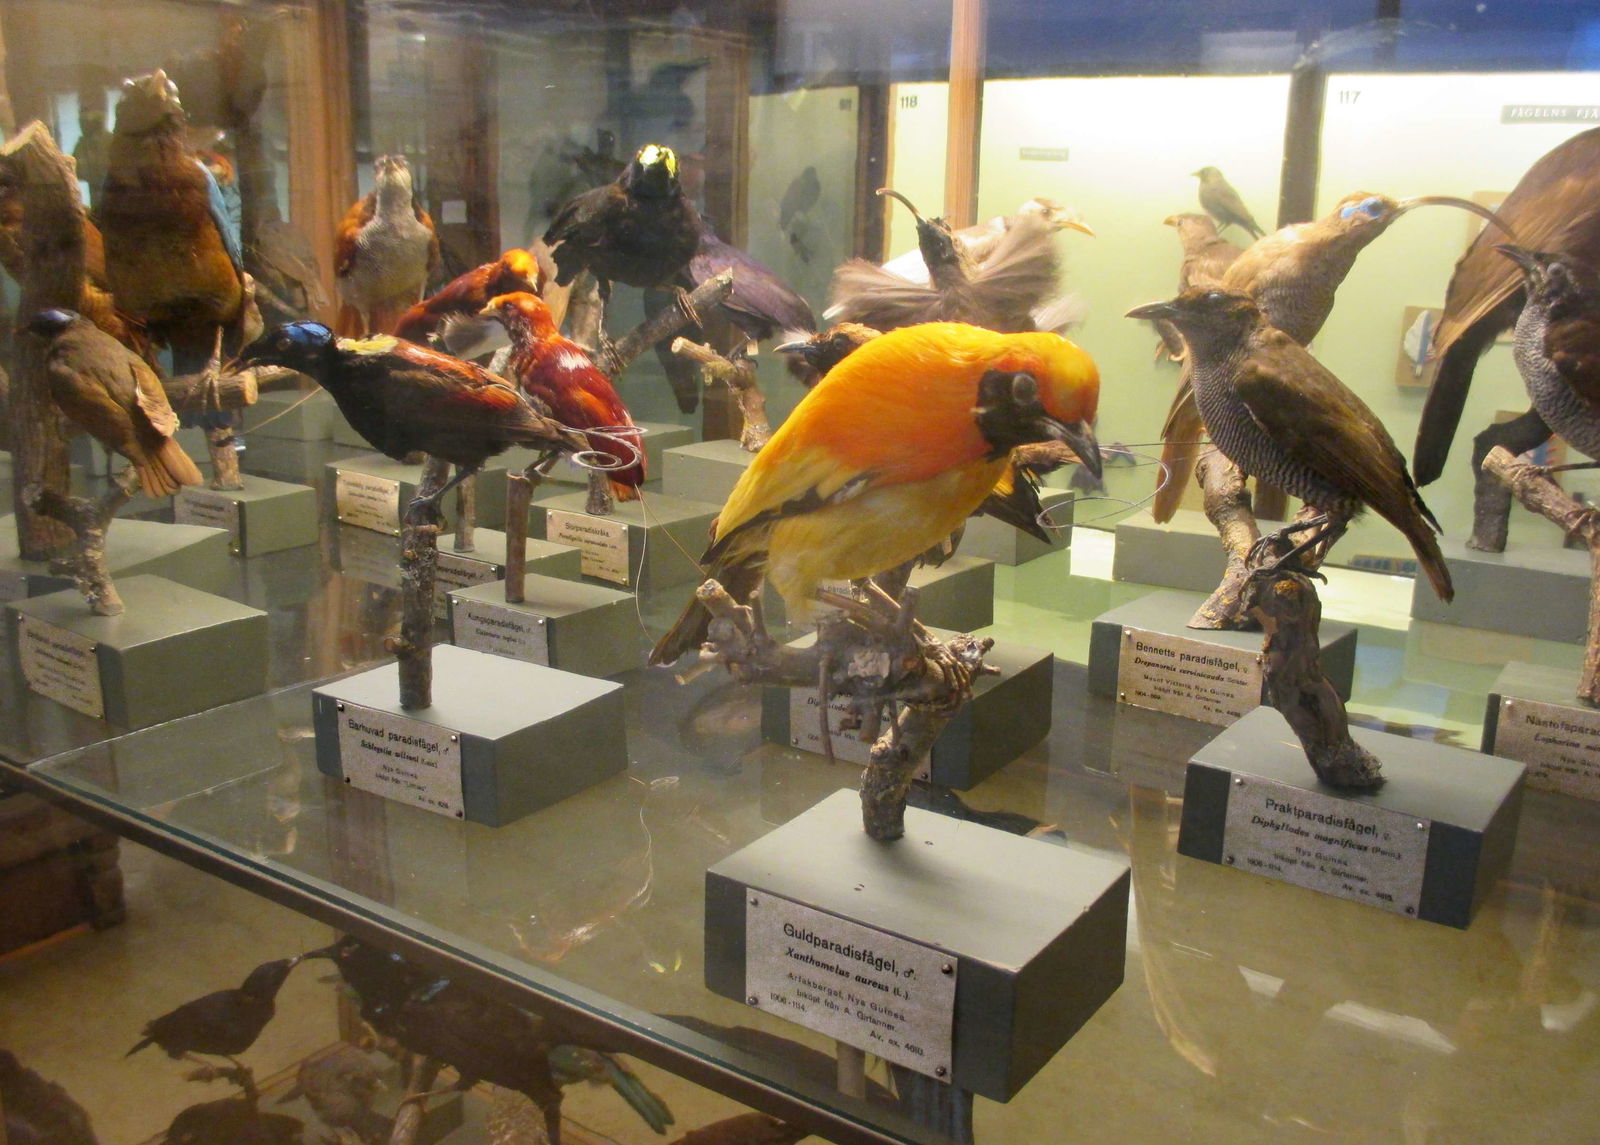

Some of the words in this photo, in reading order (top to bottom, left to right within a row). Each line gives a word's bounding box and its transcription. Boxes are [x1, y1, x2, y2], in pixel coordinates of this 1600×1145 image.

[901, 95, 918, 109] 118
[1339, 90, 1361, 104] 117
[1136, 641, 1176, 658] Bennetts
[1179, 651, 1240, 673] paradisfågel,
[388, 731, 440, 756] paradisfågel,
[1251, 815, 1310, 838] Diphyllodes
[1265, 797, 1379, 839] Praktparadisfågel,
[783, 922, 899, 977] Guldparadisfågel,
[785, 946, 850, 979] Xanthomelus
[854, 974, 889, 993] aureus
